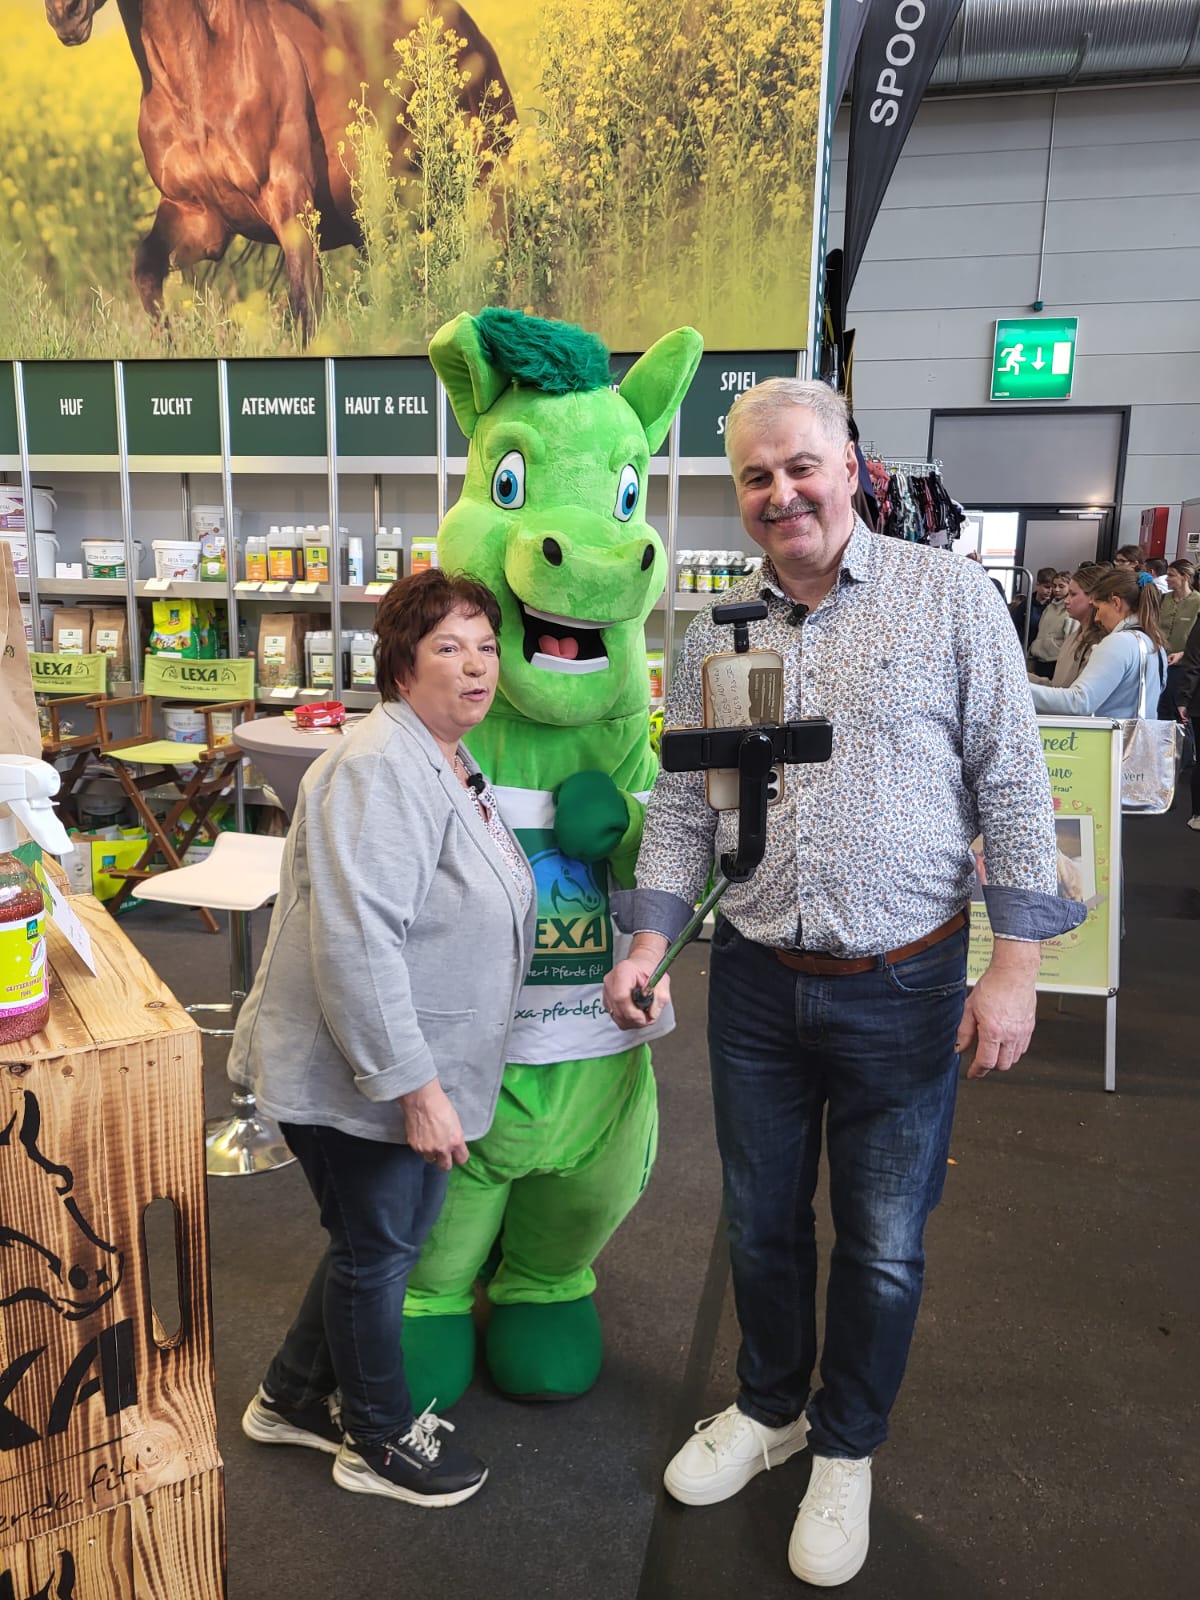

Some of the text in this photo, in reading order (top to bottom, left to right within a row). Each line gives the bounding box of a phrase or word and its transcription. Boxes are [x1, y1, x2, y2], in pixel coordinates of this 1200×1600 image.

[720, 371, 756, 391] SPIEL
[59, 398, 84, 416] HUF
[151, 397, 193, 416] ZUCHT
[241, 397, 316, 415] ATEMWEGE
[344, 396, 429, 415] HAUT & FELL
[35, 662, 72, 676] LEXA
[181, 667, 218, 682] LEXA
[1043, 731, 1079, 752] reet
[535, 916, 603, 949] EXA
[527, 965, 550, 977] tert
[551, 965, 588, 979] Pferde
[513, 998, 610, 1024] xa-pferdefu
[87, 1455, 141, 1504] fit!
